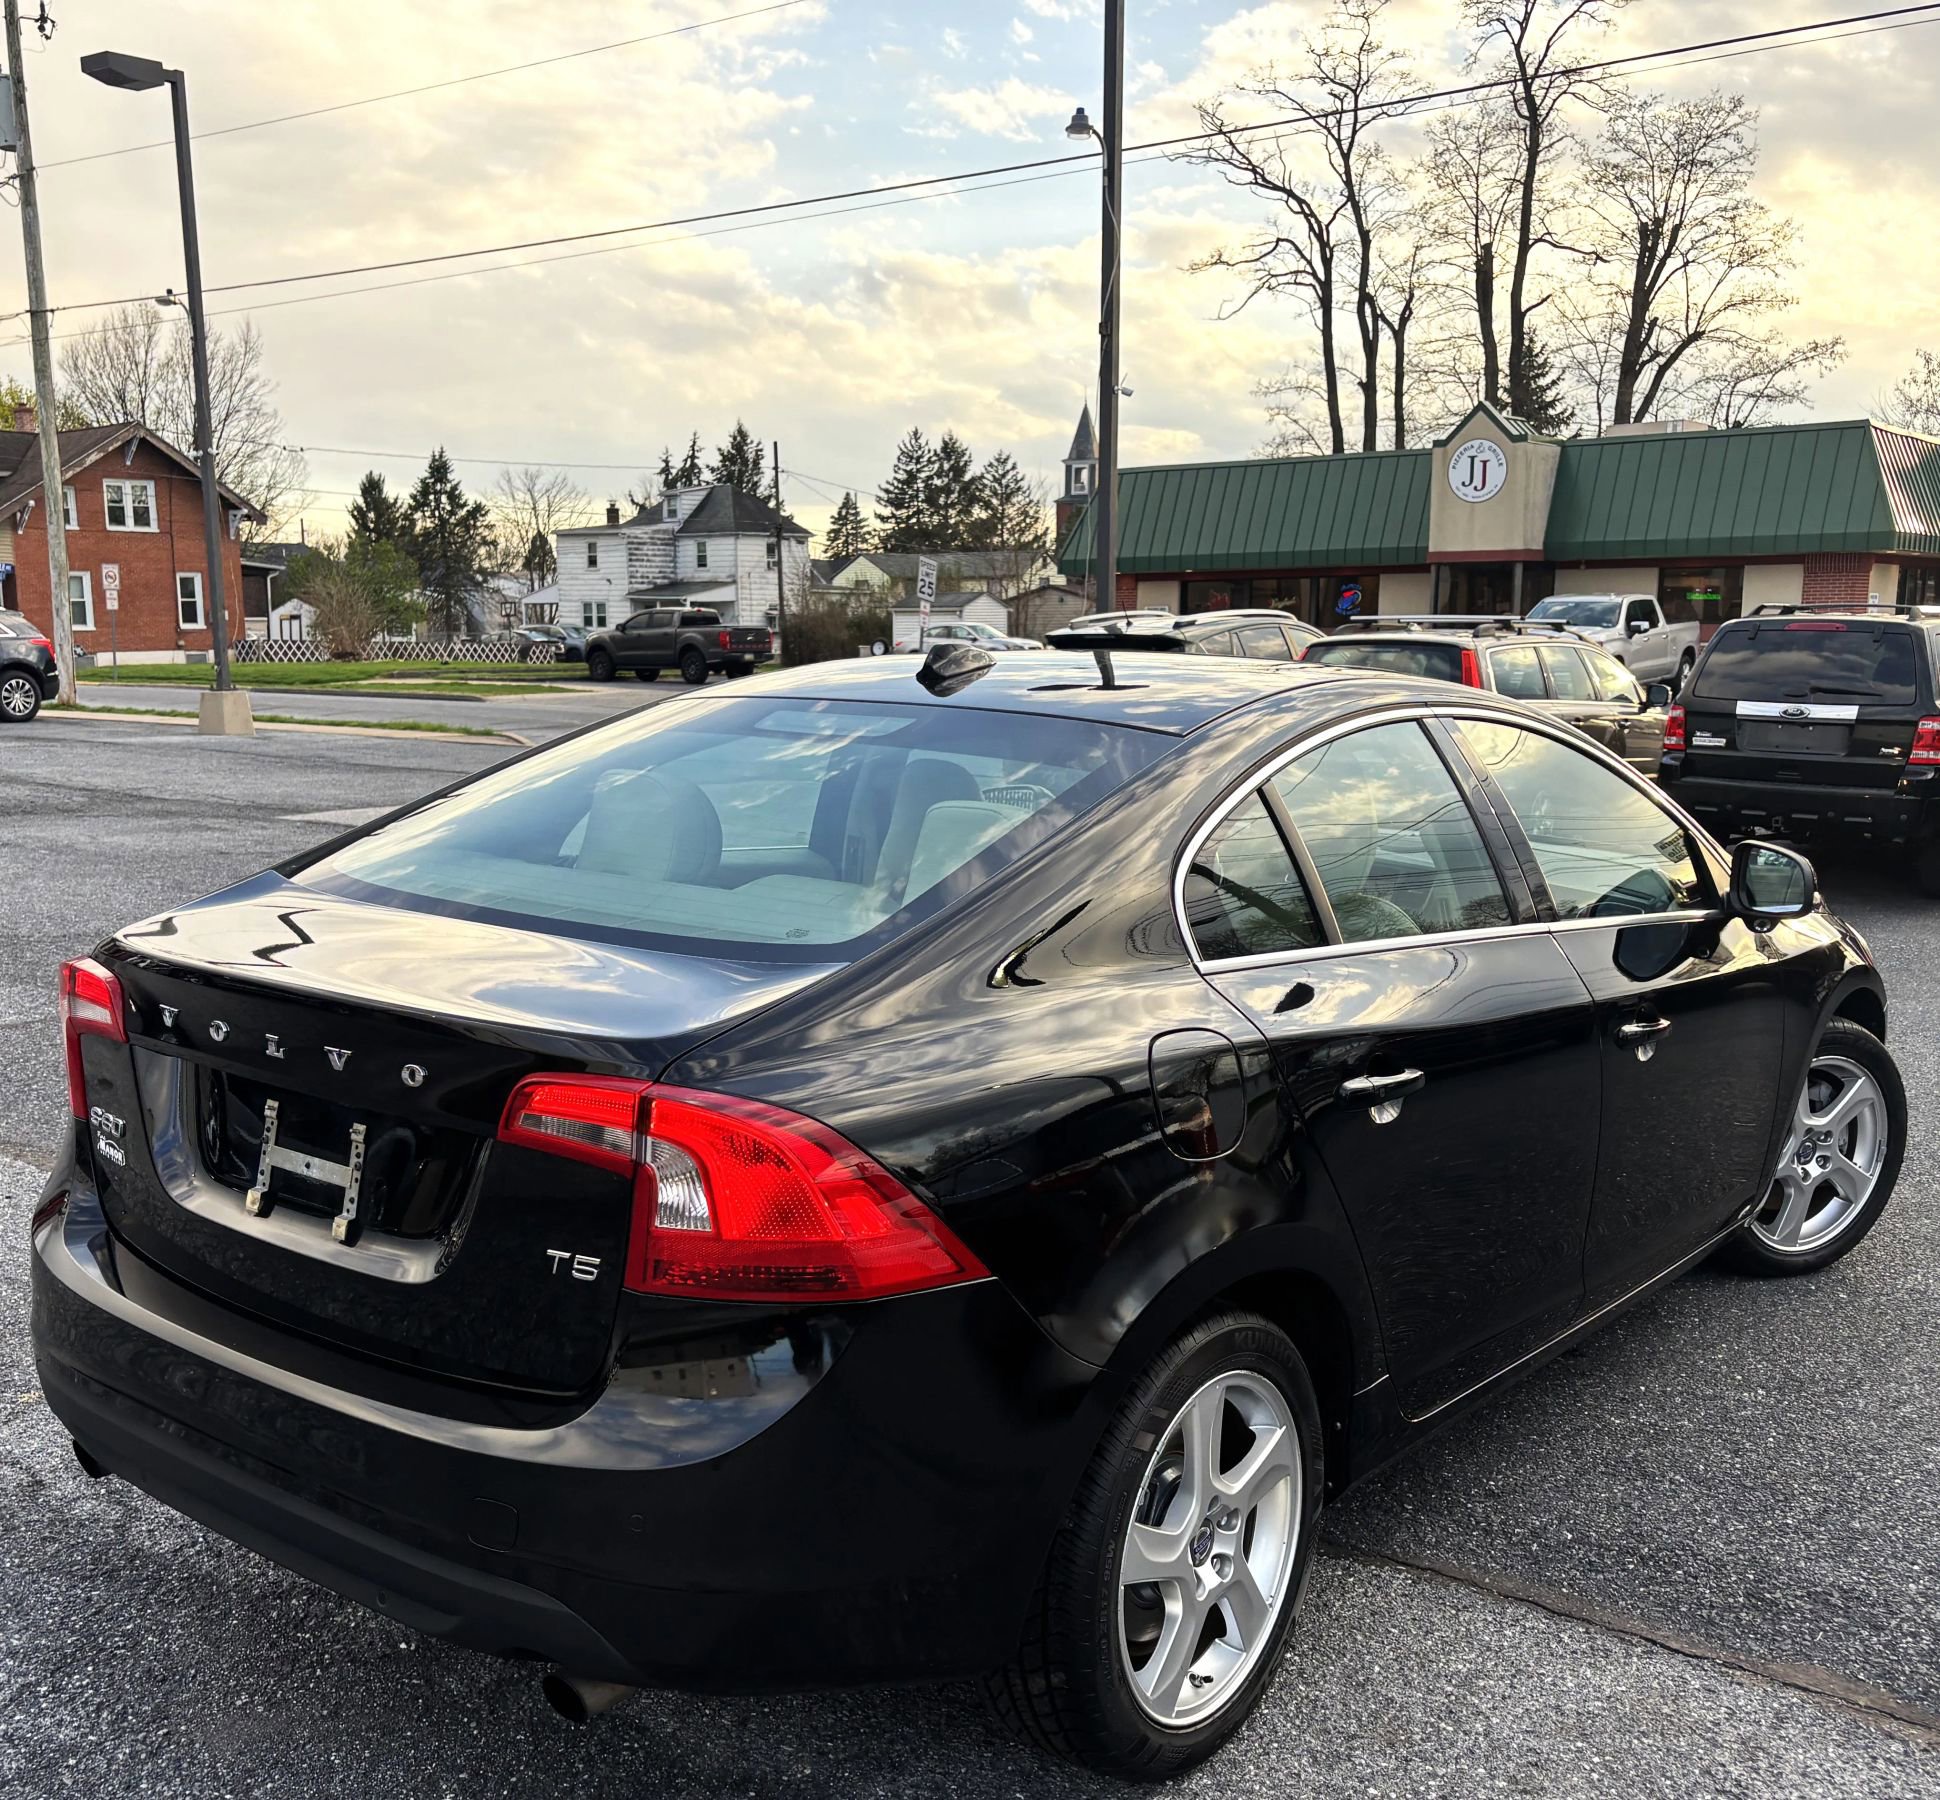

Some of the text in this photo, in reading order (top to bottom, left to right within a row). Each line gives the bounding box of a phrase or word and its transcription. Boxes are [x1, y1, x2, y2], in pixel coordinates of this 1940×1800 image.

[1452, 444, 1475, 469] PIZZERIA
[1475, 442, 1486, 454] &
[921, 560, 936, 572] SPEED
[921, 570, 934, 579] LIMIT
[919, 579, 934, 597] 25
[158, 1003, 428, 1088] VOLVO
[90, 1106, 126, 1138] S60
[547, 1249, 601, 1281] T5
[1233, 1330, 1295, 1368] KUMHO
